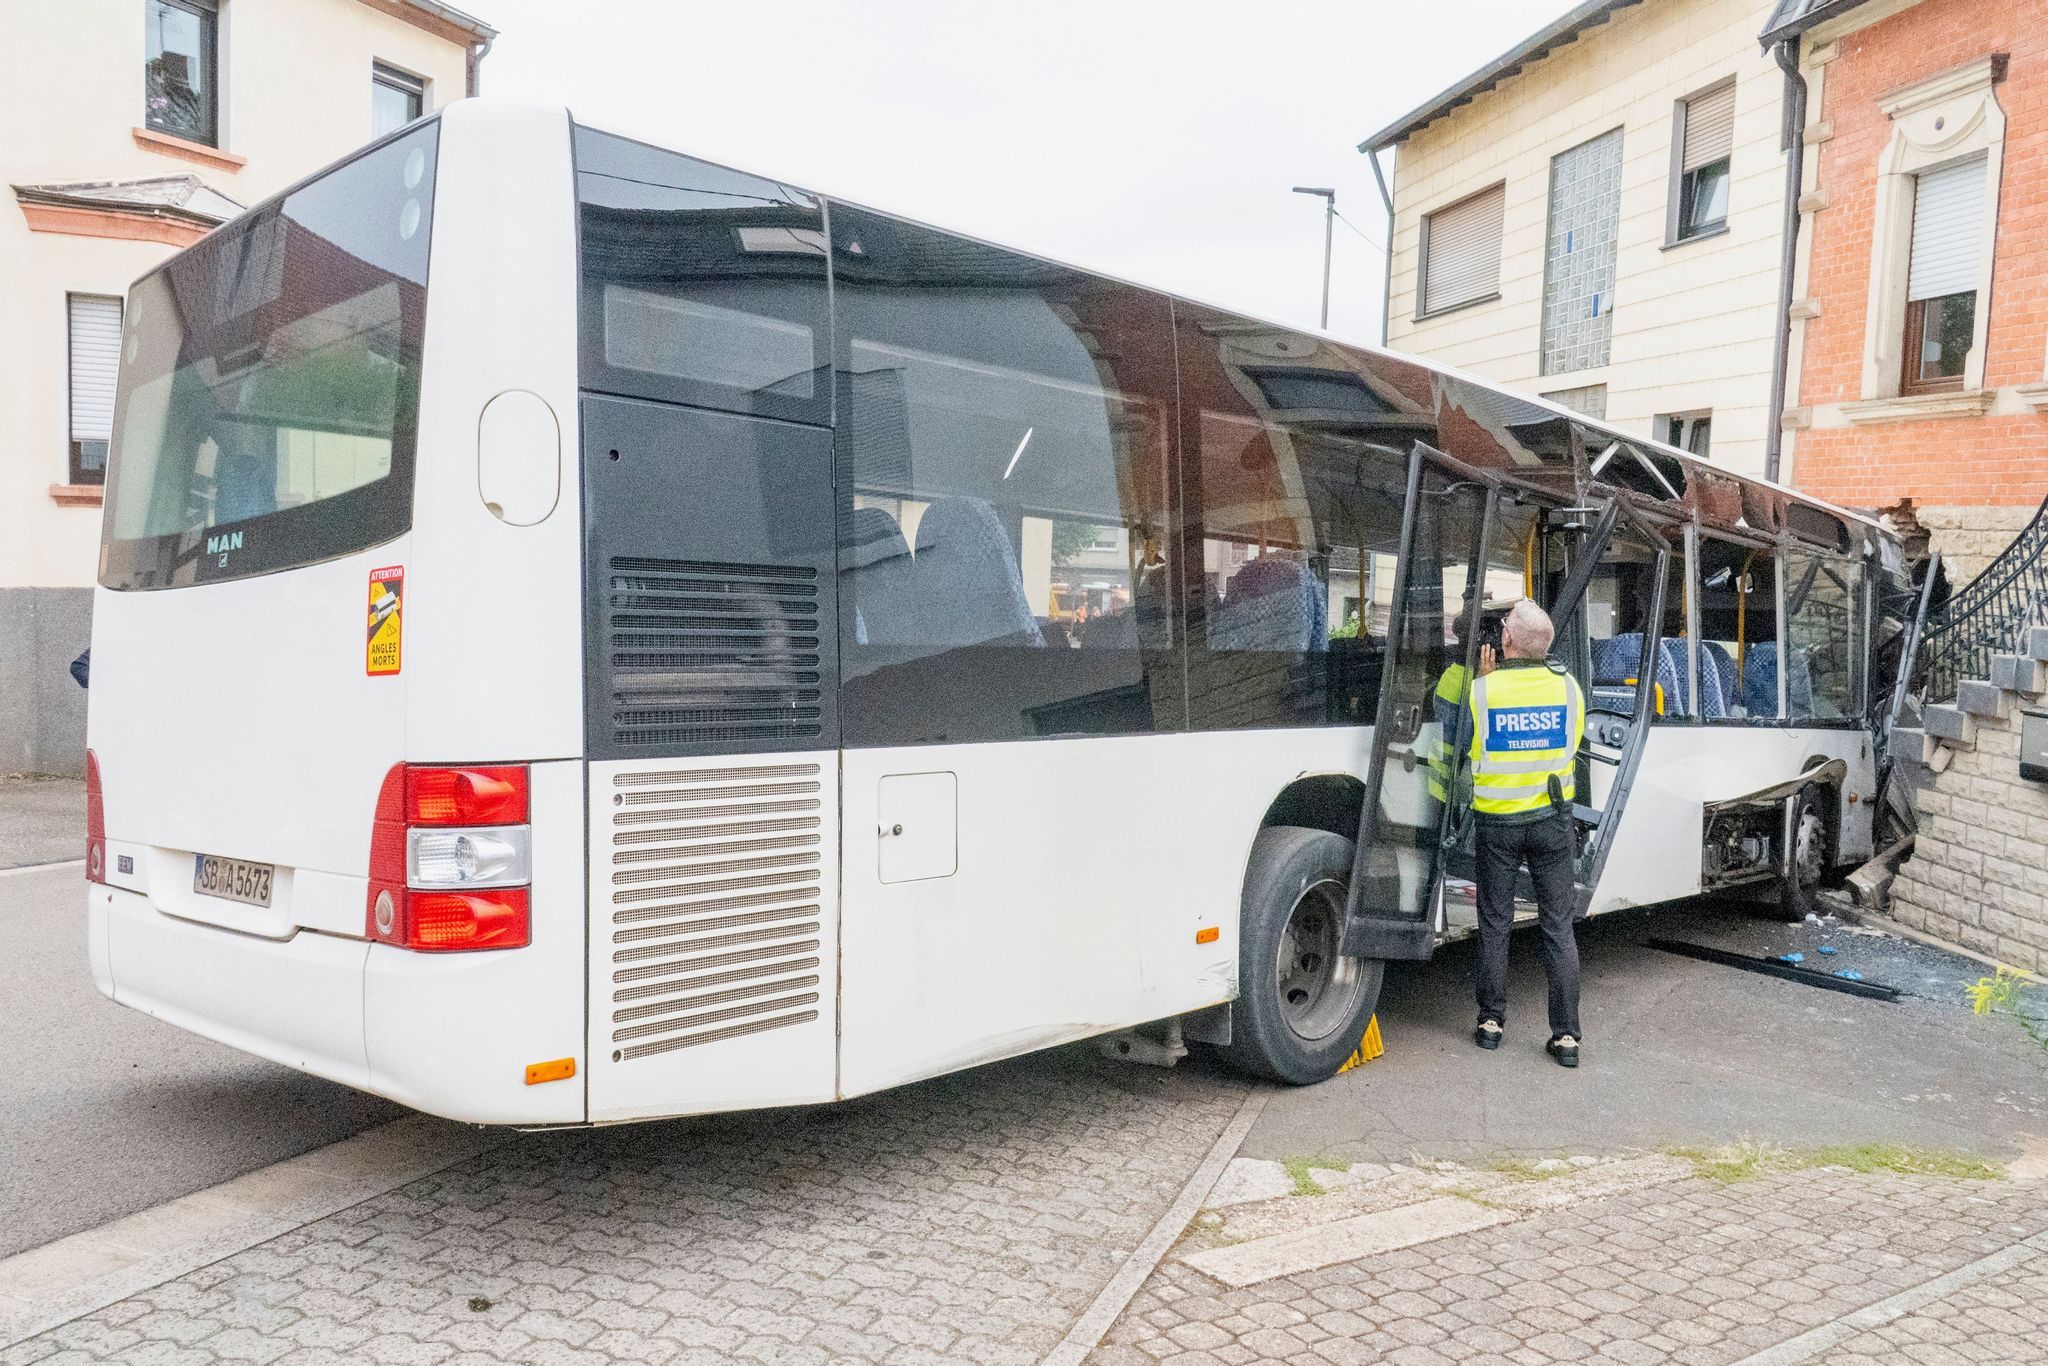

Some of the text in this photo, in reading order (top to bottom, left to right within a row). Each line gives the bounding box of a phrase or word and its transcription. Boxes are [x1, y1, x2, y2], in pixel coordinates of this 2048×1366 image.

[207, 531, 243, 555] MAN
[371, 568, 402, 580] ATTENTION
[371, 642, 397, 654] ANGLES
[372, 655, 396, 666] MORTS
[1495, 711, 1561, 732] PRESSE
[1508, 739, 1549, 749] TELEVISION
[202, 860, 218, 890] SB
